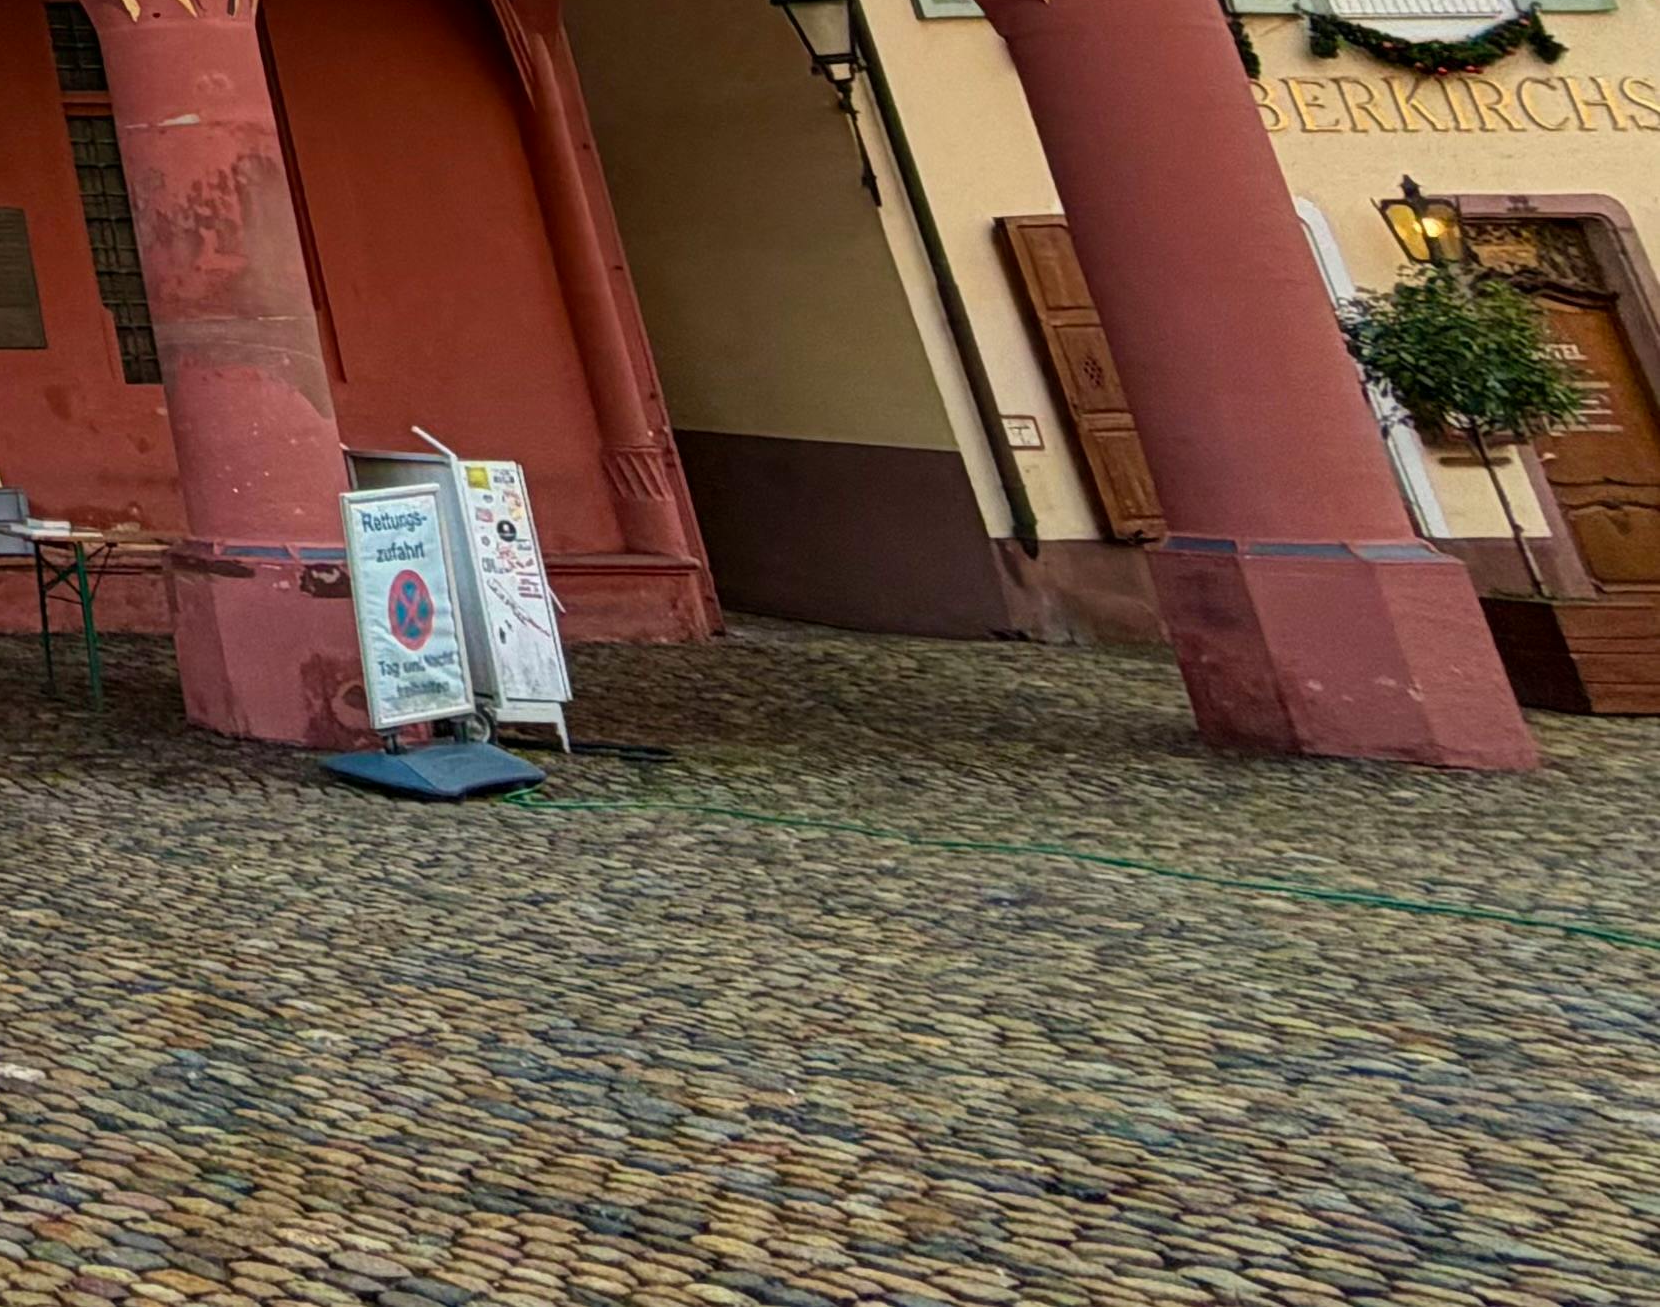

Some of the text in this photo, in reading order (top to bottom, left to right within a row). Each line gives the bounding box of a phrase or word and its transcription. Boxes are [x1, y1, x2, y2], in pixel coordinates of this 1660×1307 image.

[362, 511, 427, 533] Rettungs-
[376, 541, 426, 563] zufahrt
[378, 660, 400, 678] Tag
